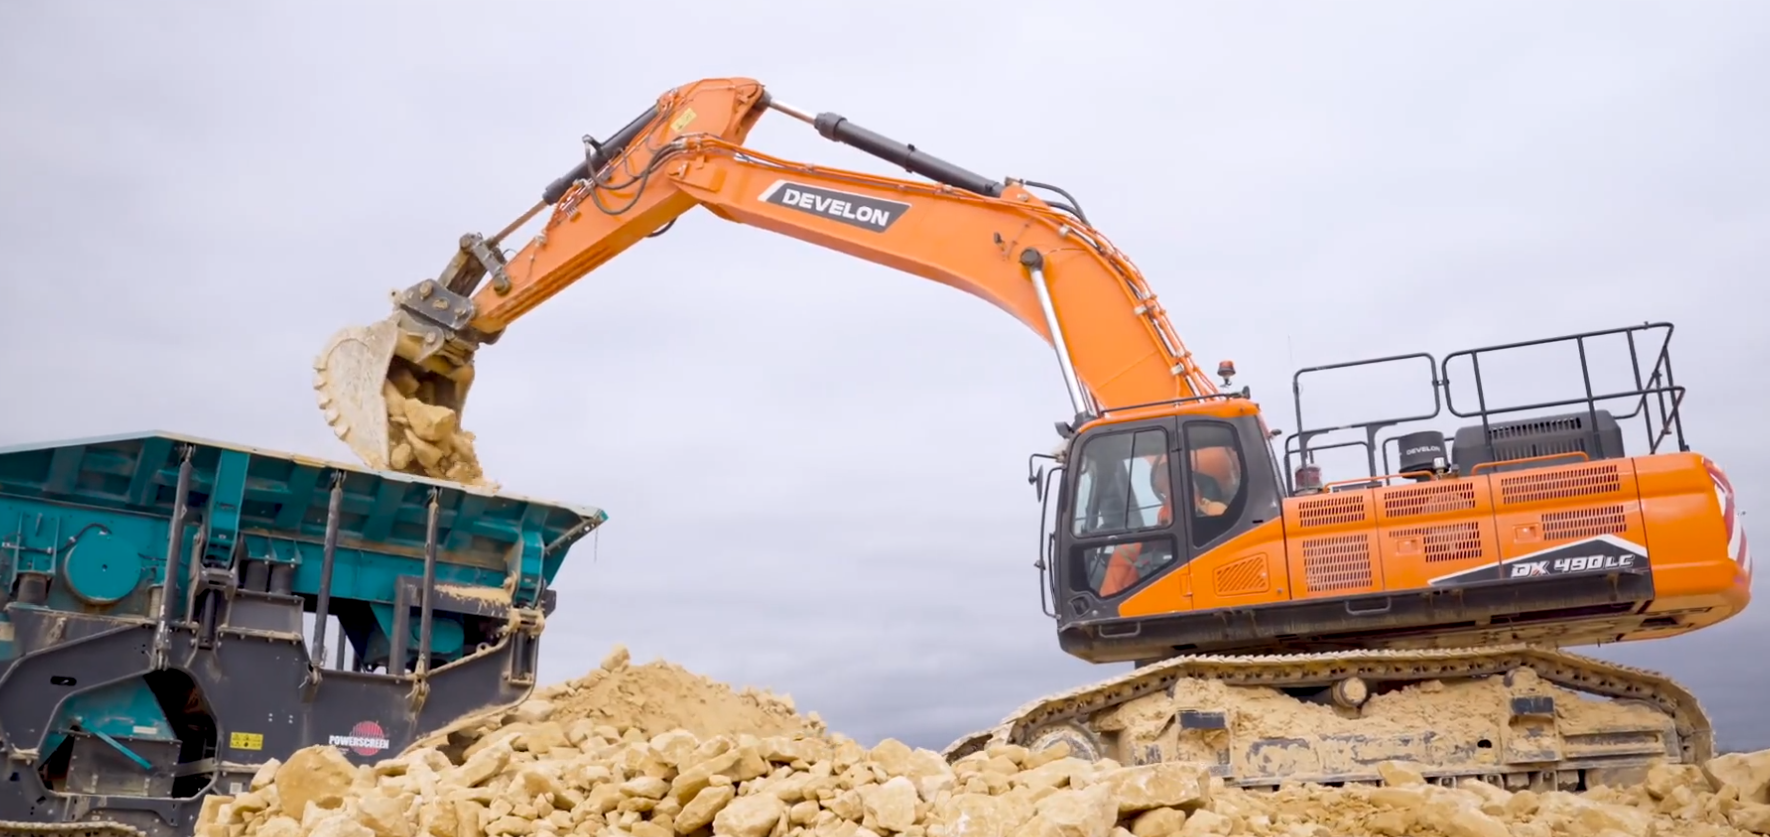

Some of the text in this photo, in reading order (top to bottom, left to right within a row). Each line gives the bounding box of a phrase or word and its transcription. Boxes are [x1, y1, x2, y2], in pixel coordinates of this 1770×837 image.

[782, 188, 890, 226] DEVELON
[1406, 445, 1441, 456] DEVELON
[1511, 561, 1550, 578] DX
[329, 735, 389, 749] POWERSCREEN
